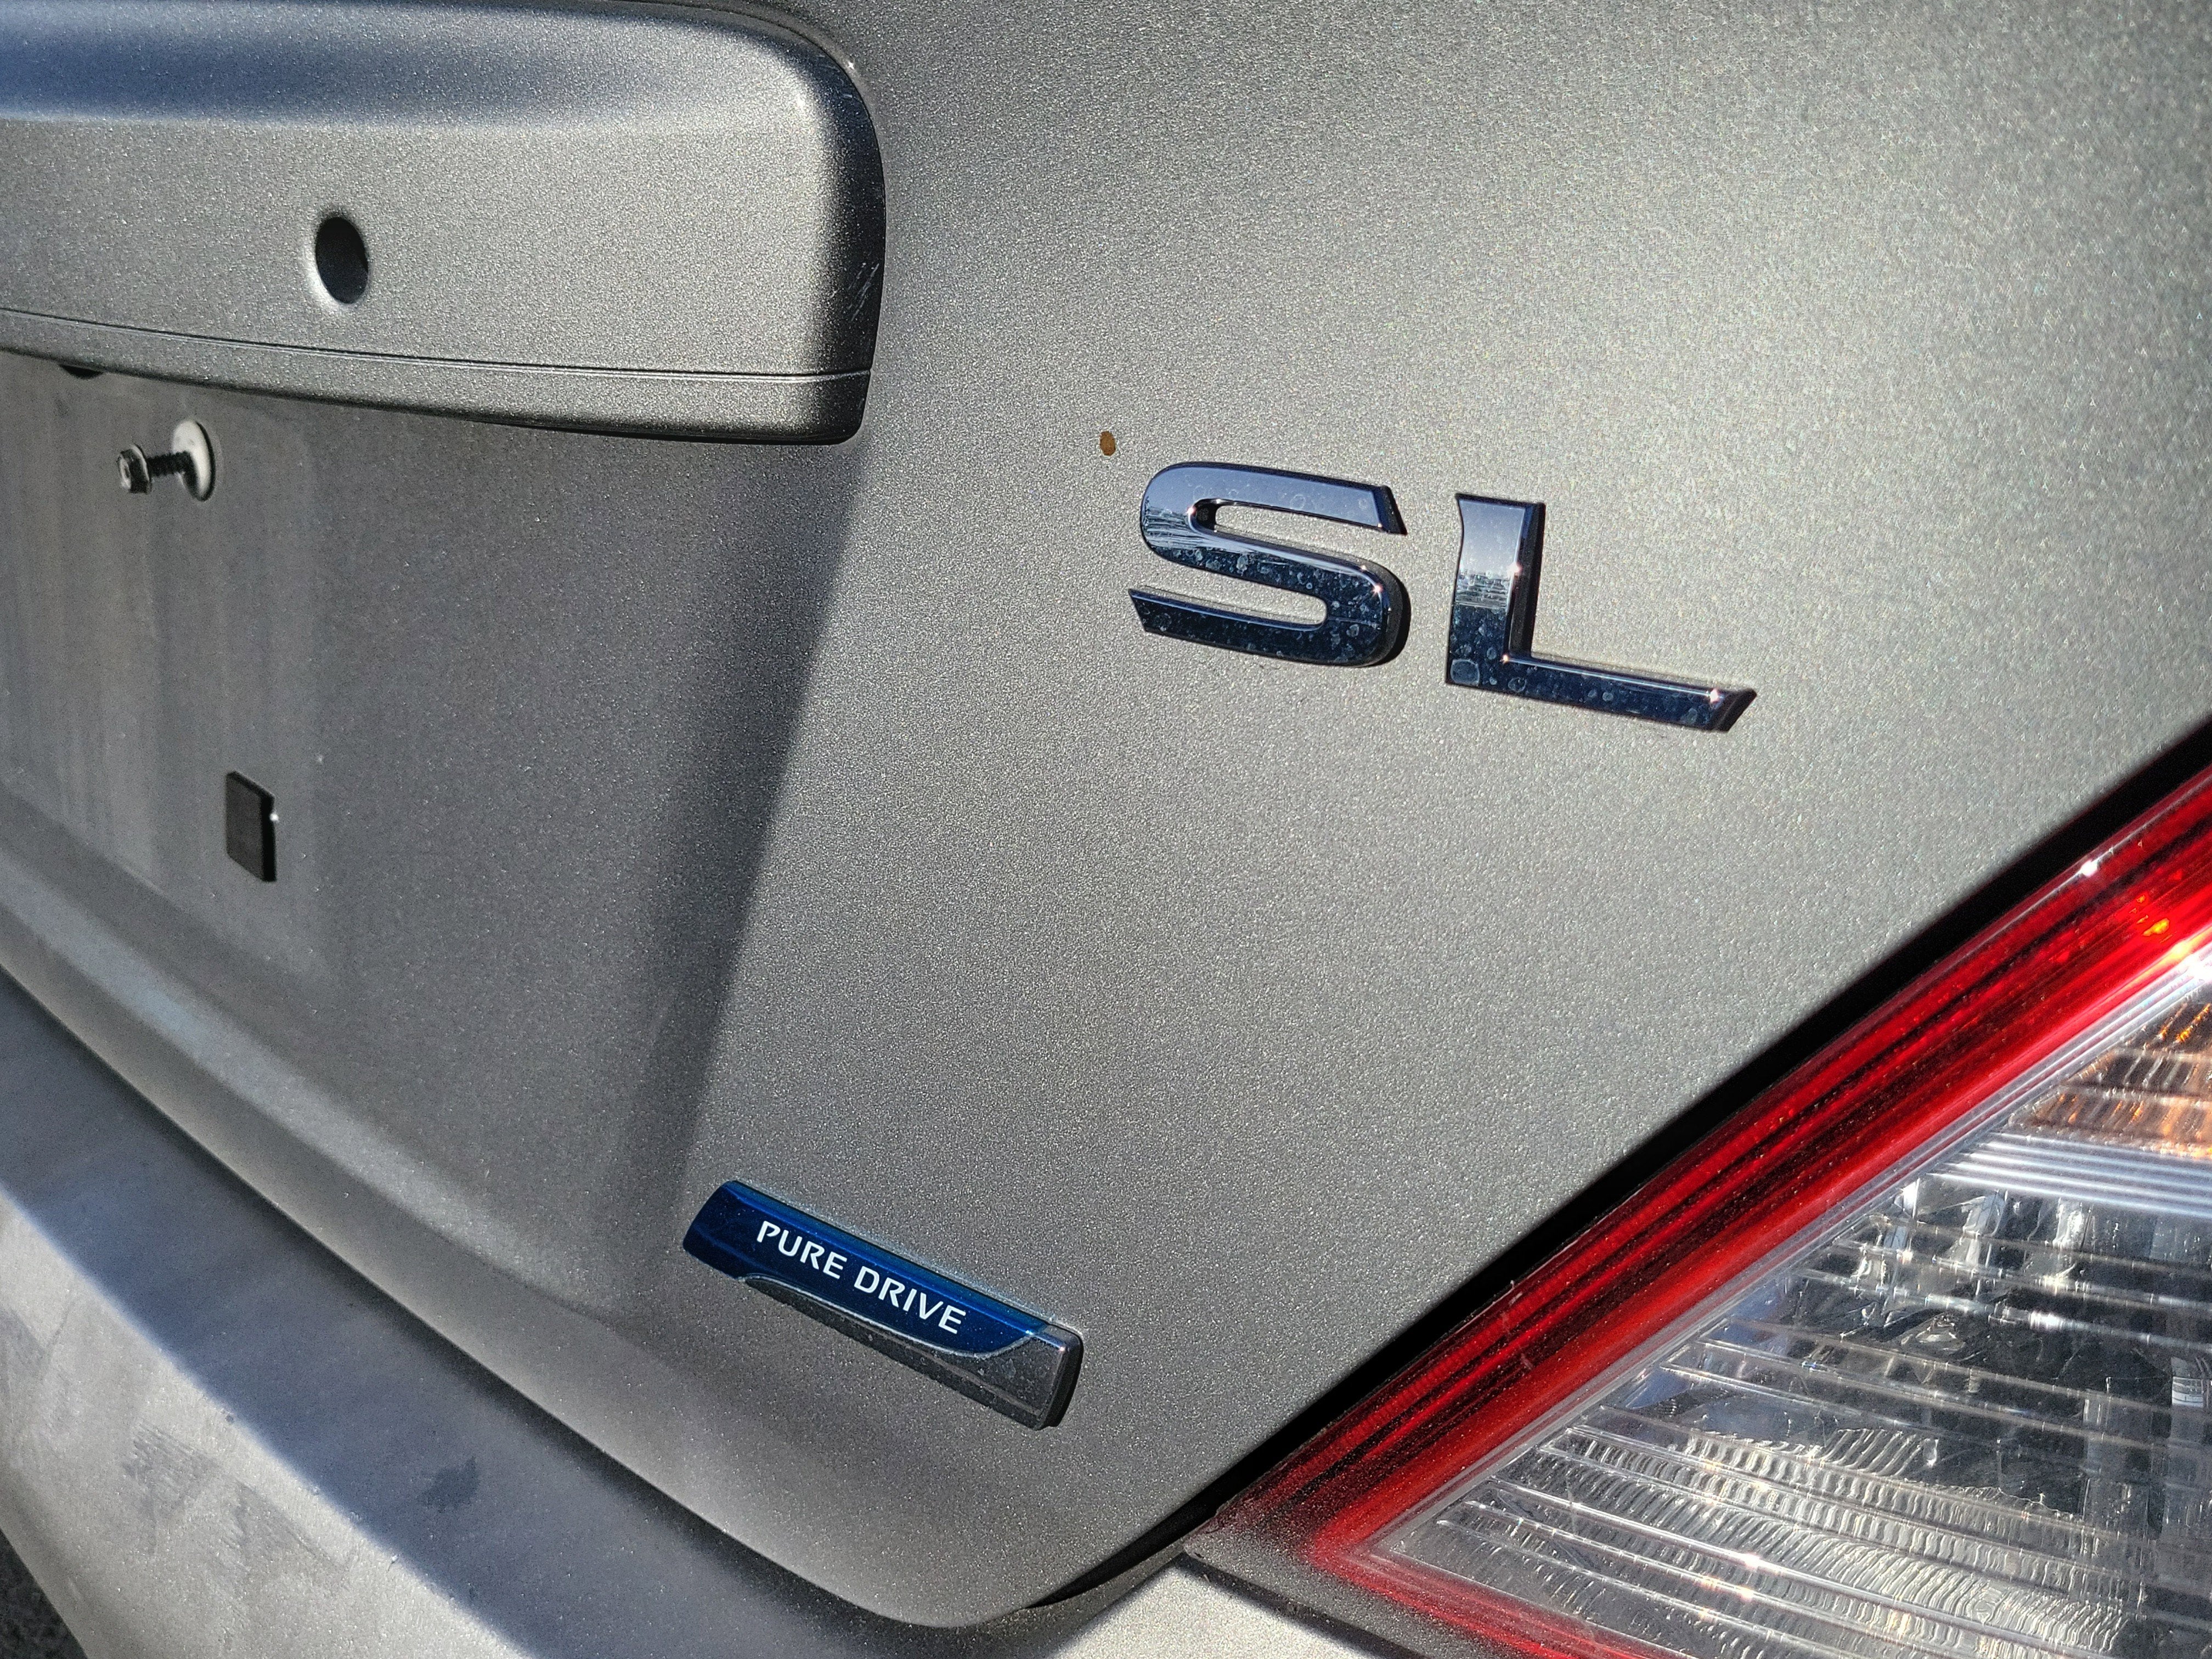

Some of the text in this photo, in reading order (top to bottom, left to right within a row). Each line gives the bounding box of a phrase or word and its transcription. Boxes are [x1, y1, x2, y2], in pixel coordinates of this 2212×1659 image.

[1128, 461, 1757, 733] SL
[756, 1220, 967, 1334] PURE DRIVE
